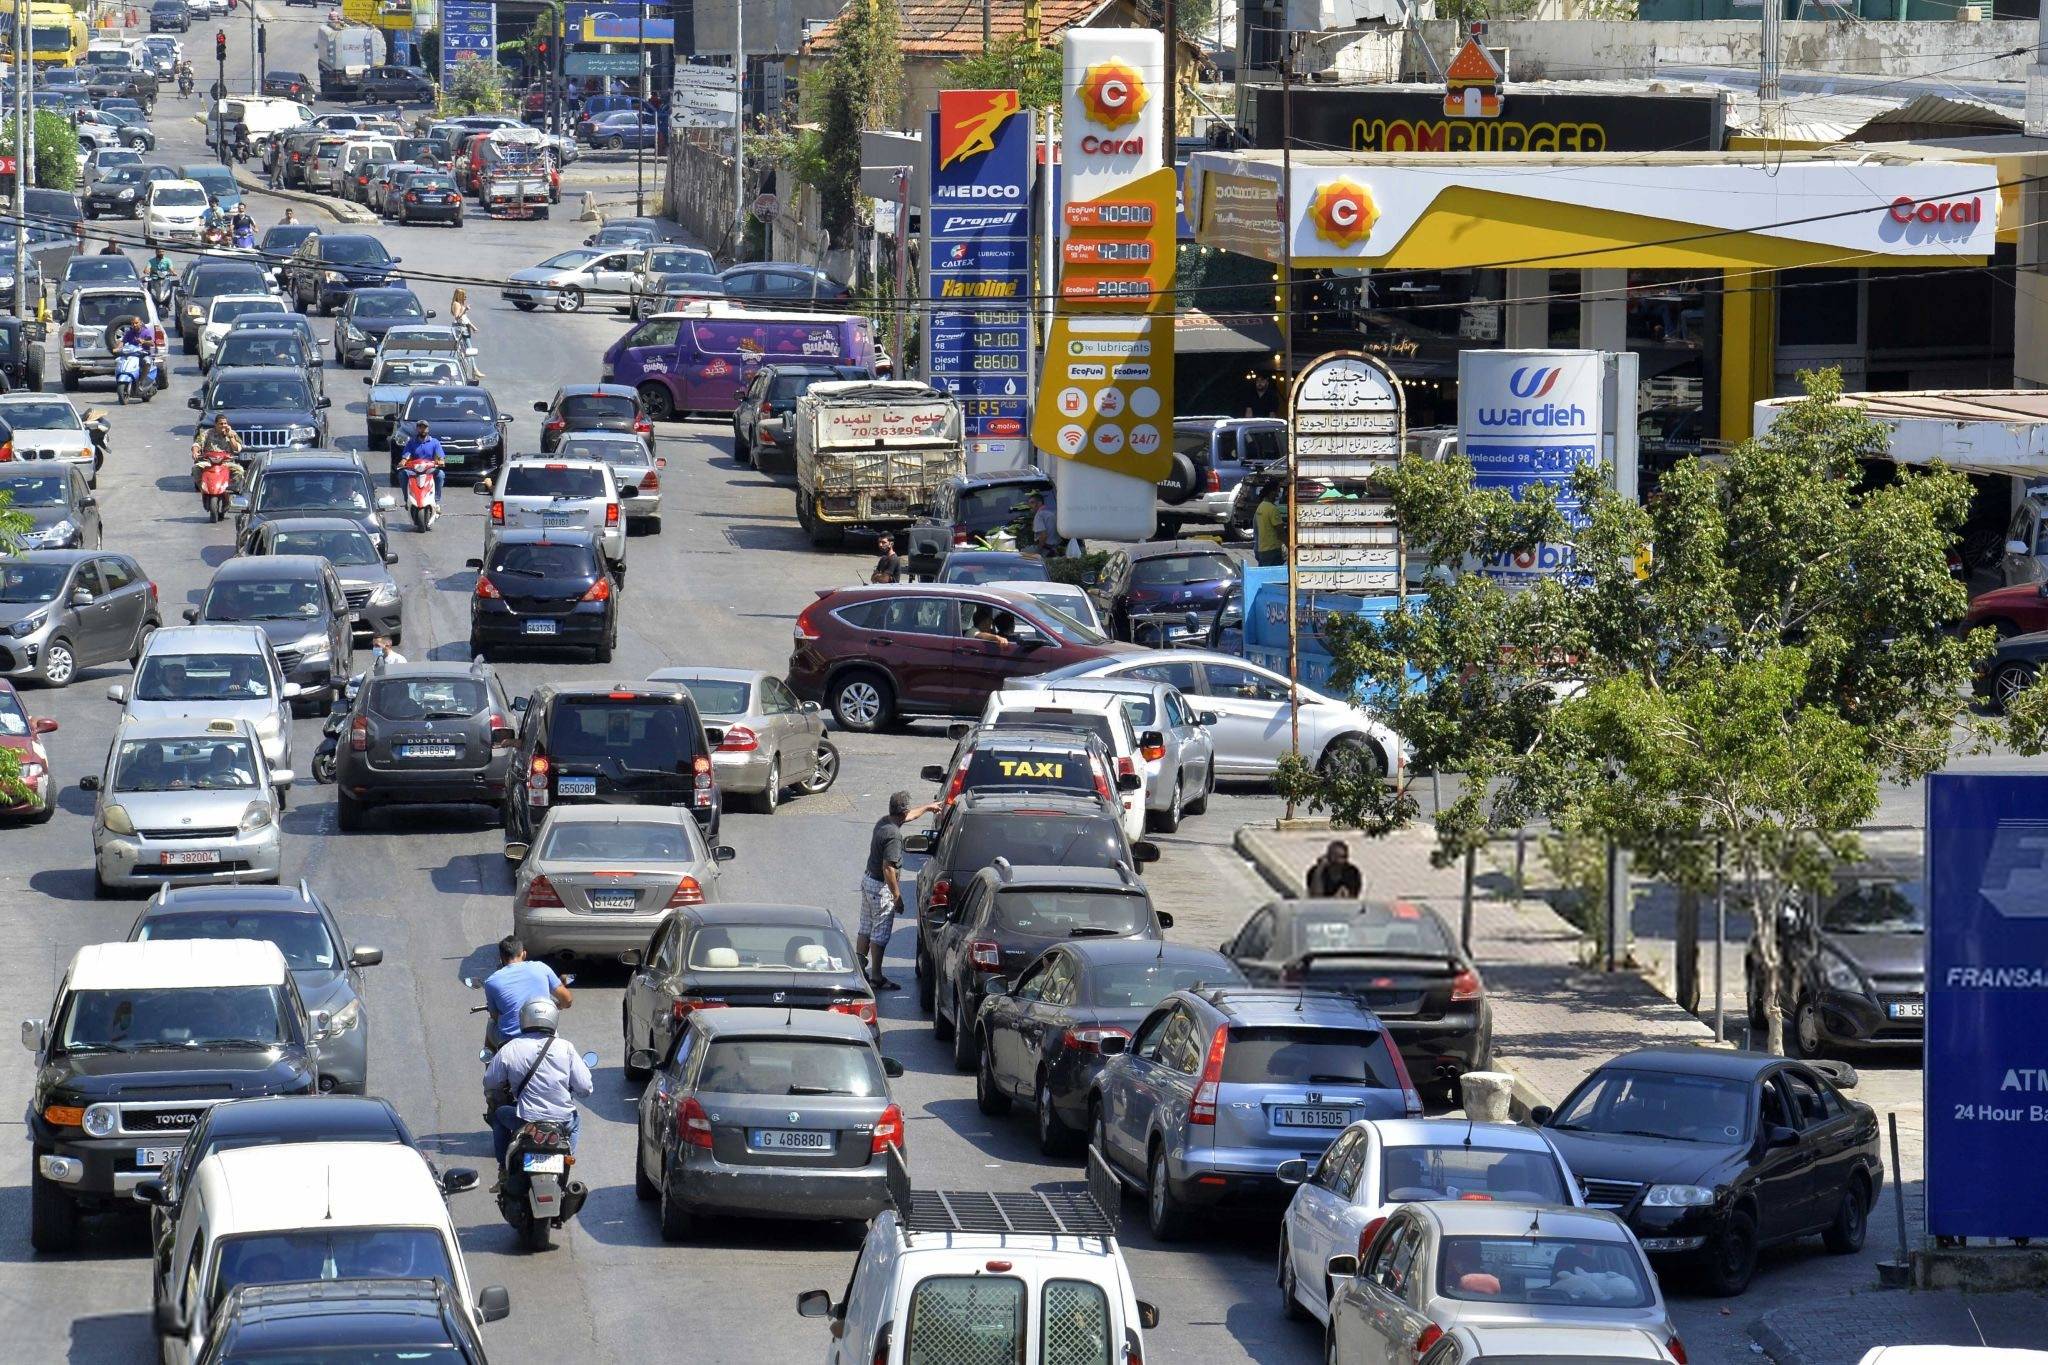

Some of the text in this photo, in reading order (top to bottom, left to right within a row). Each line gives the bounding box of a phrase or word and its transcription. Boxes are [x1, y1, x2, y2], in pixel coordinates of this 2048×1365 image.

[1081, 135, 1144, 155] Coral
[938, 185, 1020, 198] MEDCO
[1098, 206, 1152, 223] 40900
[1890, 196, 1981, 224] Coral
[944, 212, 1018, 233] Propell
[941, 259, 975, 268] CALTEX
[941, 279, 1017, 297] Havoline
[934, 342, 946, 350] 98
[974, 332, 1020, 347] 42100
[801, 340, 841, 356] Bubbly
[1097, 343, 1150, 353] lubricants
[642, 362, 669, 374] Bubbly
[934, 355, 1020, 370] Diesel 28600
[1071, 366, 1104, 377] EcoFuel
[1321, 367, 1372, 387] الجيش
[1348, 390, 1392, 407] مبنى
[1478, 404, 1586, 427] wardieh
[1300, 416, 1330, 430] الجوية
[1363, 416, 1394, 430] قيادة
[852, 426, 922, 437] 70/363295
[1131, 433, 1158, 444] 24/7
[1469, 453, 1515, 463] Unleaded
[1517, 454, 1530, 463] 98
[999, 761, 1063, 779] TAXI
[559, 783, 596, 794] G550280
[169, 853, 213, 864] P 382004
[1946, 967, 2048, 988] FRANSA
[1899, 1005, 1906, 1016] B
[155, 1114, 197, 1124] TOYOTA
[1285, 1110, 1343, 1125] N 161505
[1954, 1104, 1975, 1120] 24
[1978, 1105, 2024, 1122] Hour
[764, 1133, 824, 1147] G 486880
[146, 1151, 155, 1164] G
